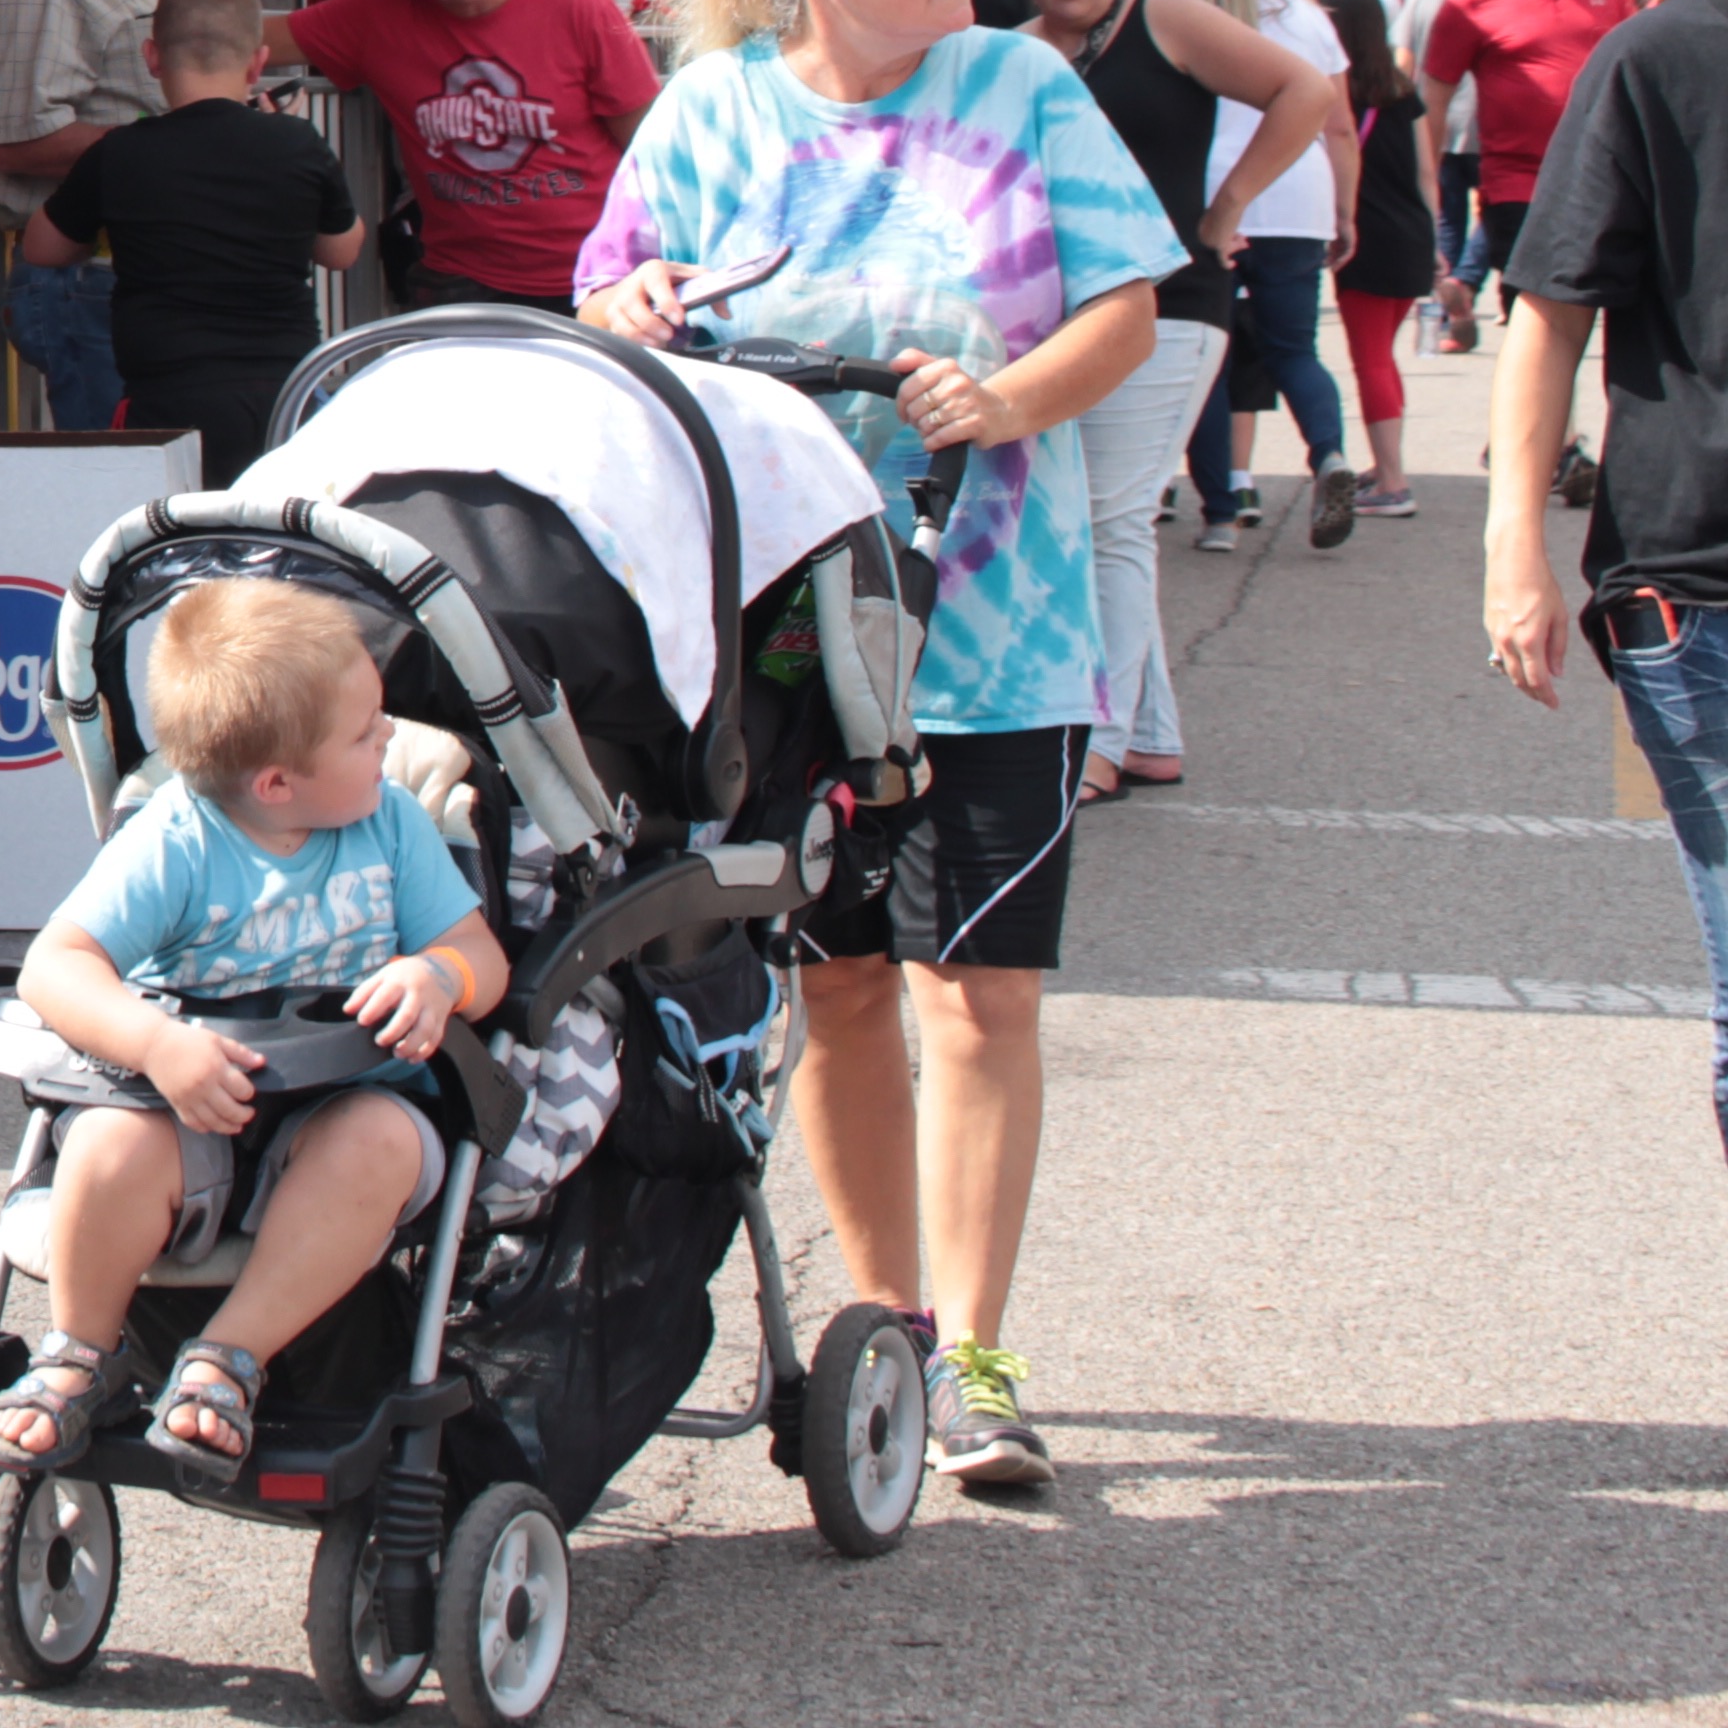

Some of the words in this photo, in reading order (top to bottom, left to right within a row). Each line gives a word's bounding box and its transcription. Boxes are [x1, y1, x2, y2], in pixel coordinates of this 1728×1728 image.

[416, 95, 474, 159] OHIO
[471, 86, 566, 154] STATE
[427, 169, 586, 206] BUCKEYES
[773, 353, 798, 364] Fold
[235, 864, 395, 956] MAKE
